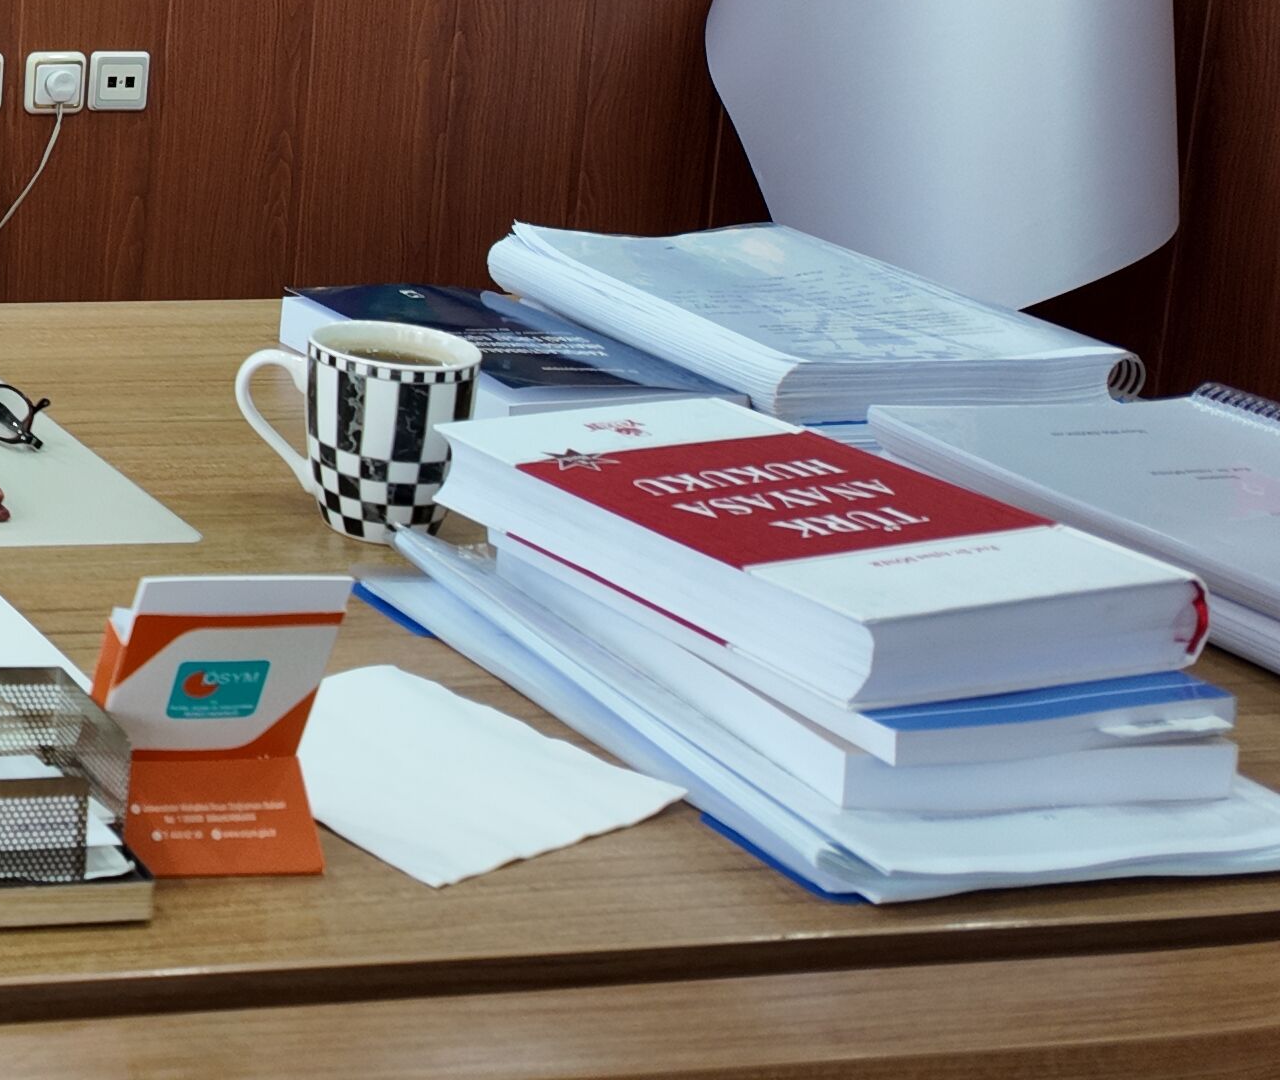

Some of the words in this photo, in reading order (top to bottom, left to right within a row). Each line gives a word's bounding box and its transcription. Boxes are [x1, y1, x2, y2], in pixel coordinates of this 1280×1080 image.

[632, 458, 848, 497] HUKUKU
[671, 479, 896, 519] ANAYASA
[768, 506, 931, 539] TÜRK
